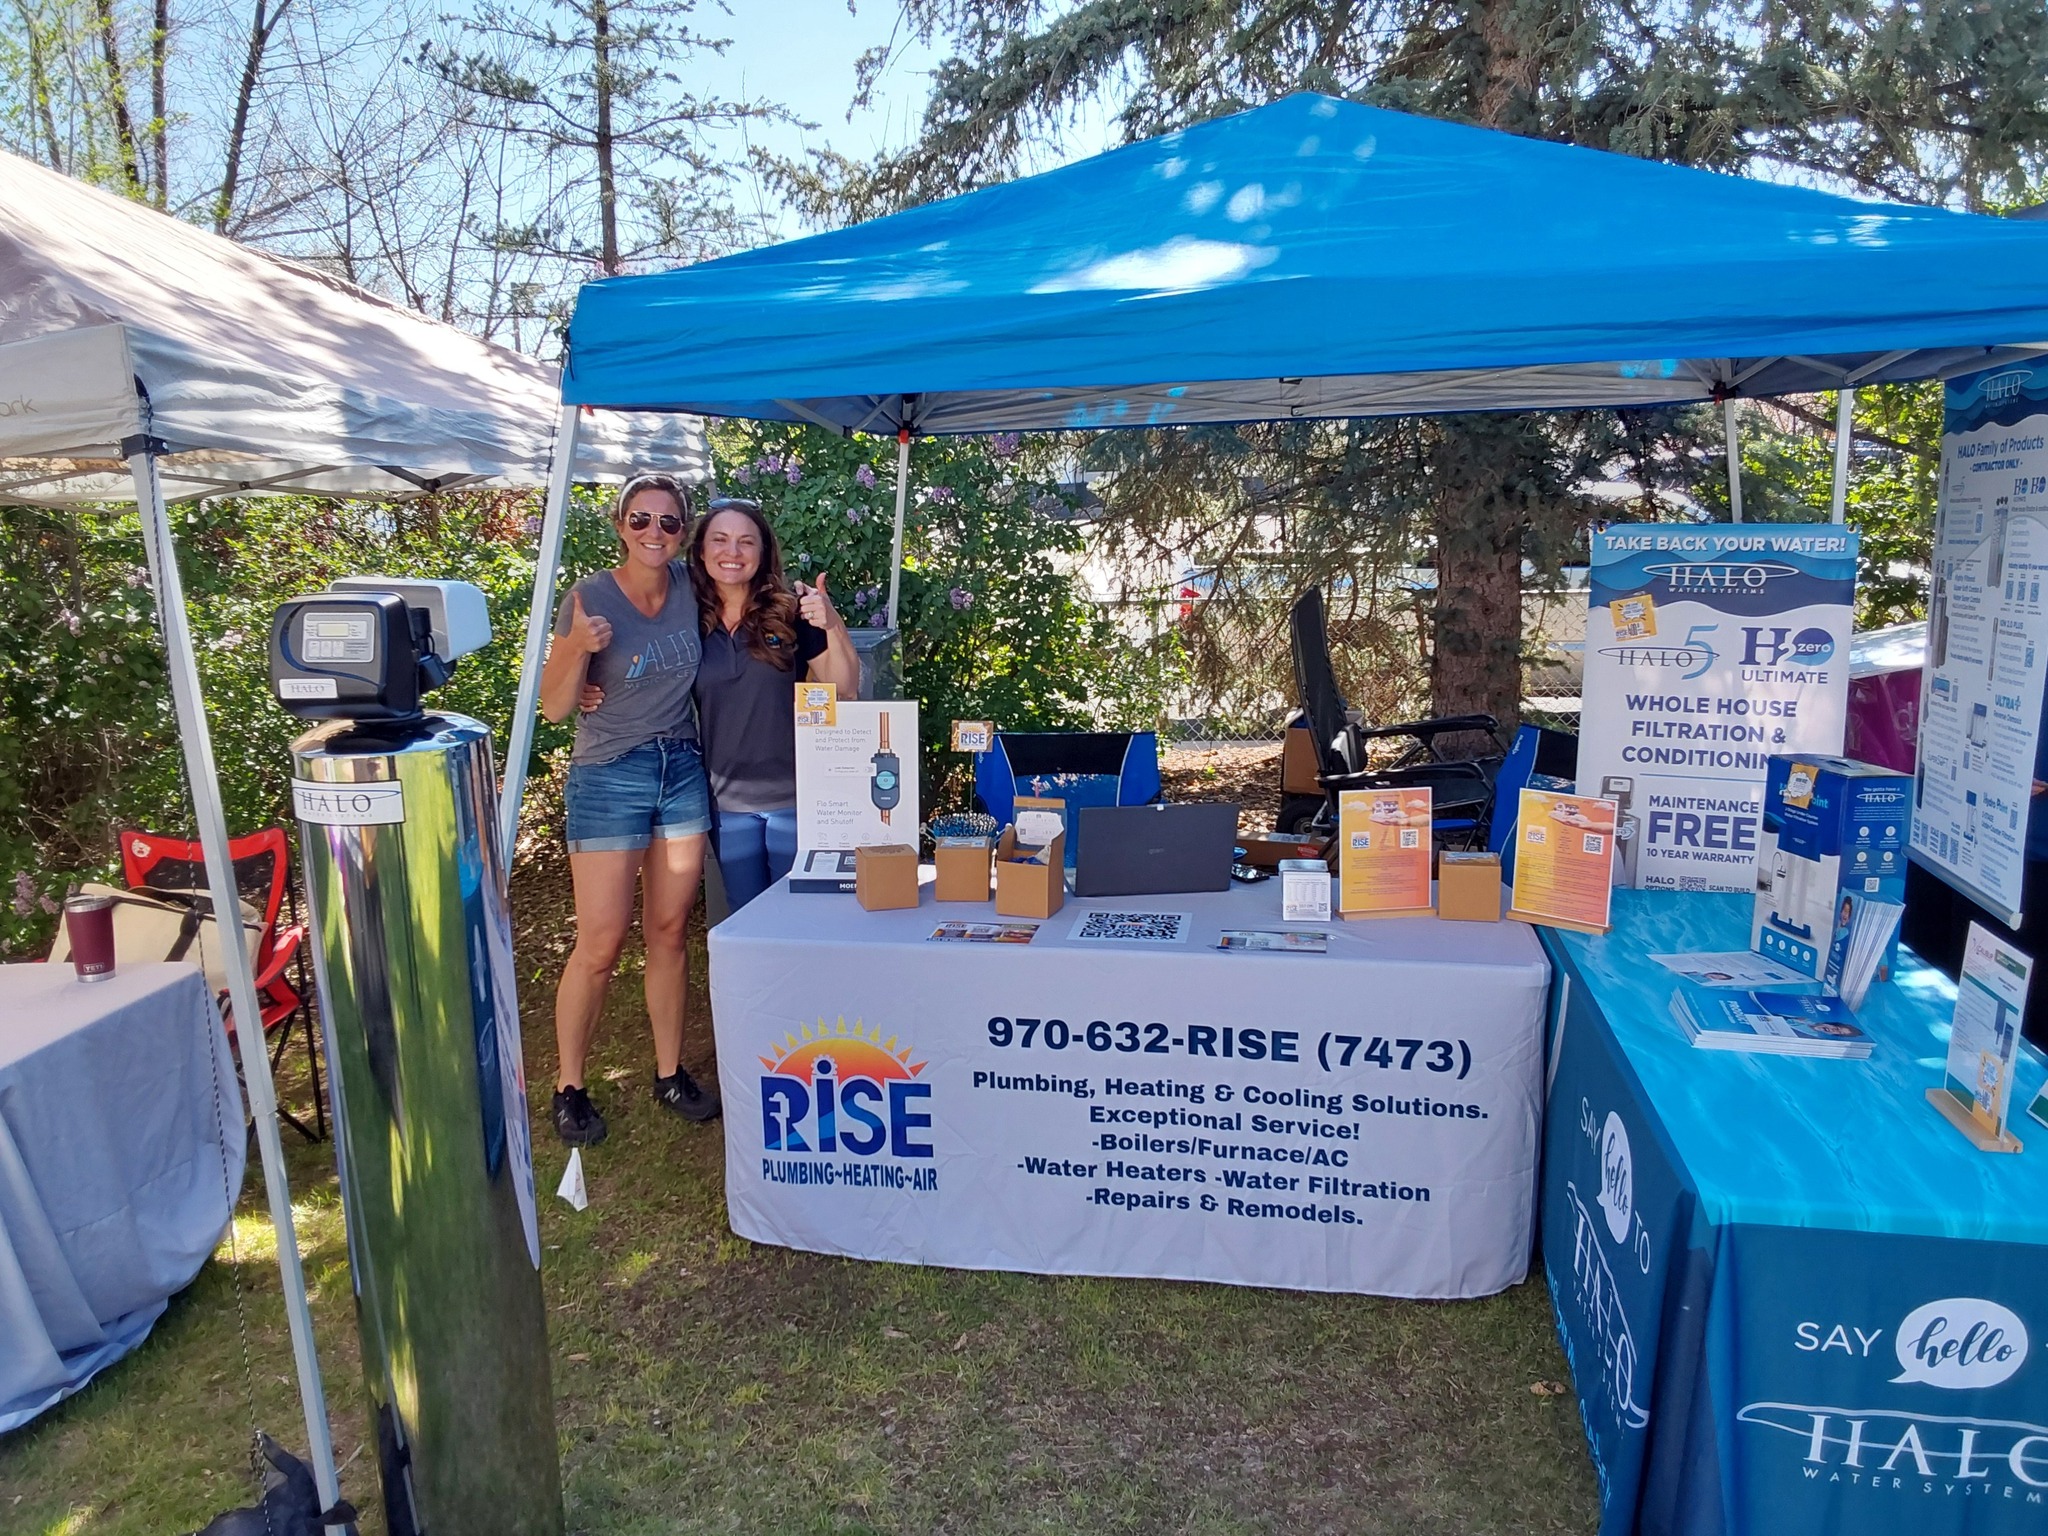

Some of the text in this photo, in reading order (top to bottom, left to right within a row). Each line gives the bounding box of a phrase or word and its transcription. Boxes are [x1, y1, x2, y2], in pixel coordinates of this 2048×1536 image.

[1986, 374, 2020, 402] HALO
[1958, 435, 2044, 459] HALO Family of Products
[1605, 536, 1846, 552] TAKE BACK YOUR WATER!
[1669, 566, 1767, 588] HALO
[1797, 641, 1832, 653] zero
[1618, 650, 1693, 668] HALO
[1742, 669, 1828, 684] ULTIMATE
[291, 685, 324, 693] HALO
[1625, 694, 1797, 717] WHOLE HOUSE
[961, 731, 985, 744] RISE
[1632, 720, 1786, 743] FILTRATION &
[835, 745, 860, 753] Damage
[1622, 746, 1768, 770] CONDITIONIN
[301, 791, 371, 812] HALO
[1649, 795, 1759, 814] MAINTENANCE
[1811, 794, 1829, 809] oint
[1865, 794, 1896, 803] HALO
[1353, 837, 1369, 846] RISE
[1528, 832, 1545, 842] RISE
[1648, 811, 1757, 851] FREE
[1647, 848, 1755, 865] 10 YEAR WARRANTY
[1646, 875, 1675, 885] HALO
[987, 1016, 1472, 1080] 970-632-RISE (7473)
[973, 1071, 1489, 1119] Plumbing, Heating & Cooling Solutions.
[1090, 1105, 1360, 1140] Exceptional Service!
[1092, 1133, 1349, 1168] -Boilers/Furnace/AC
[1017, 1156, 1430, 1202] -Water Heaters -Water Filtration
[1580, 1096, 1650, 1275] SAY hello TO
[1086, 1187, 1363, 1225] -Repairs & Remodels.
[1794, 1316, 2017, 1368] SAY hello
[1803, 1466, 1901, 1489] WATER
